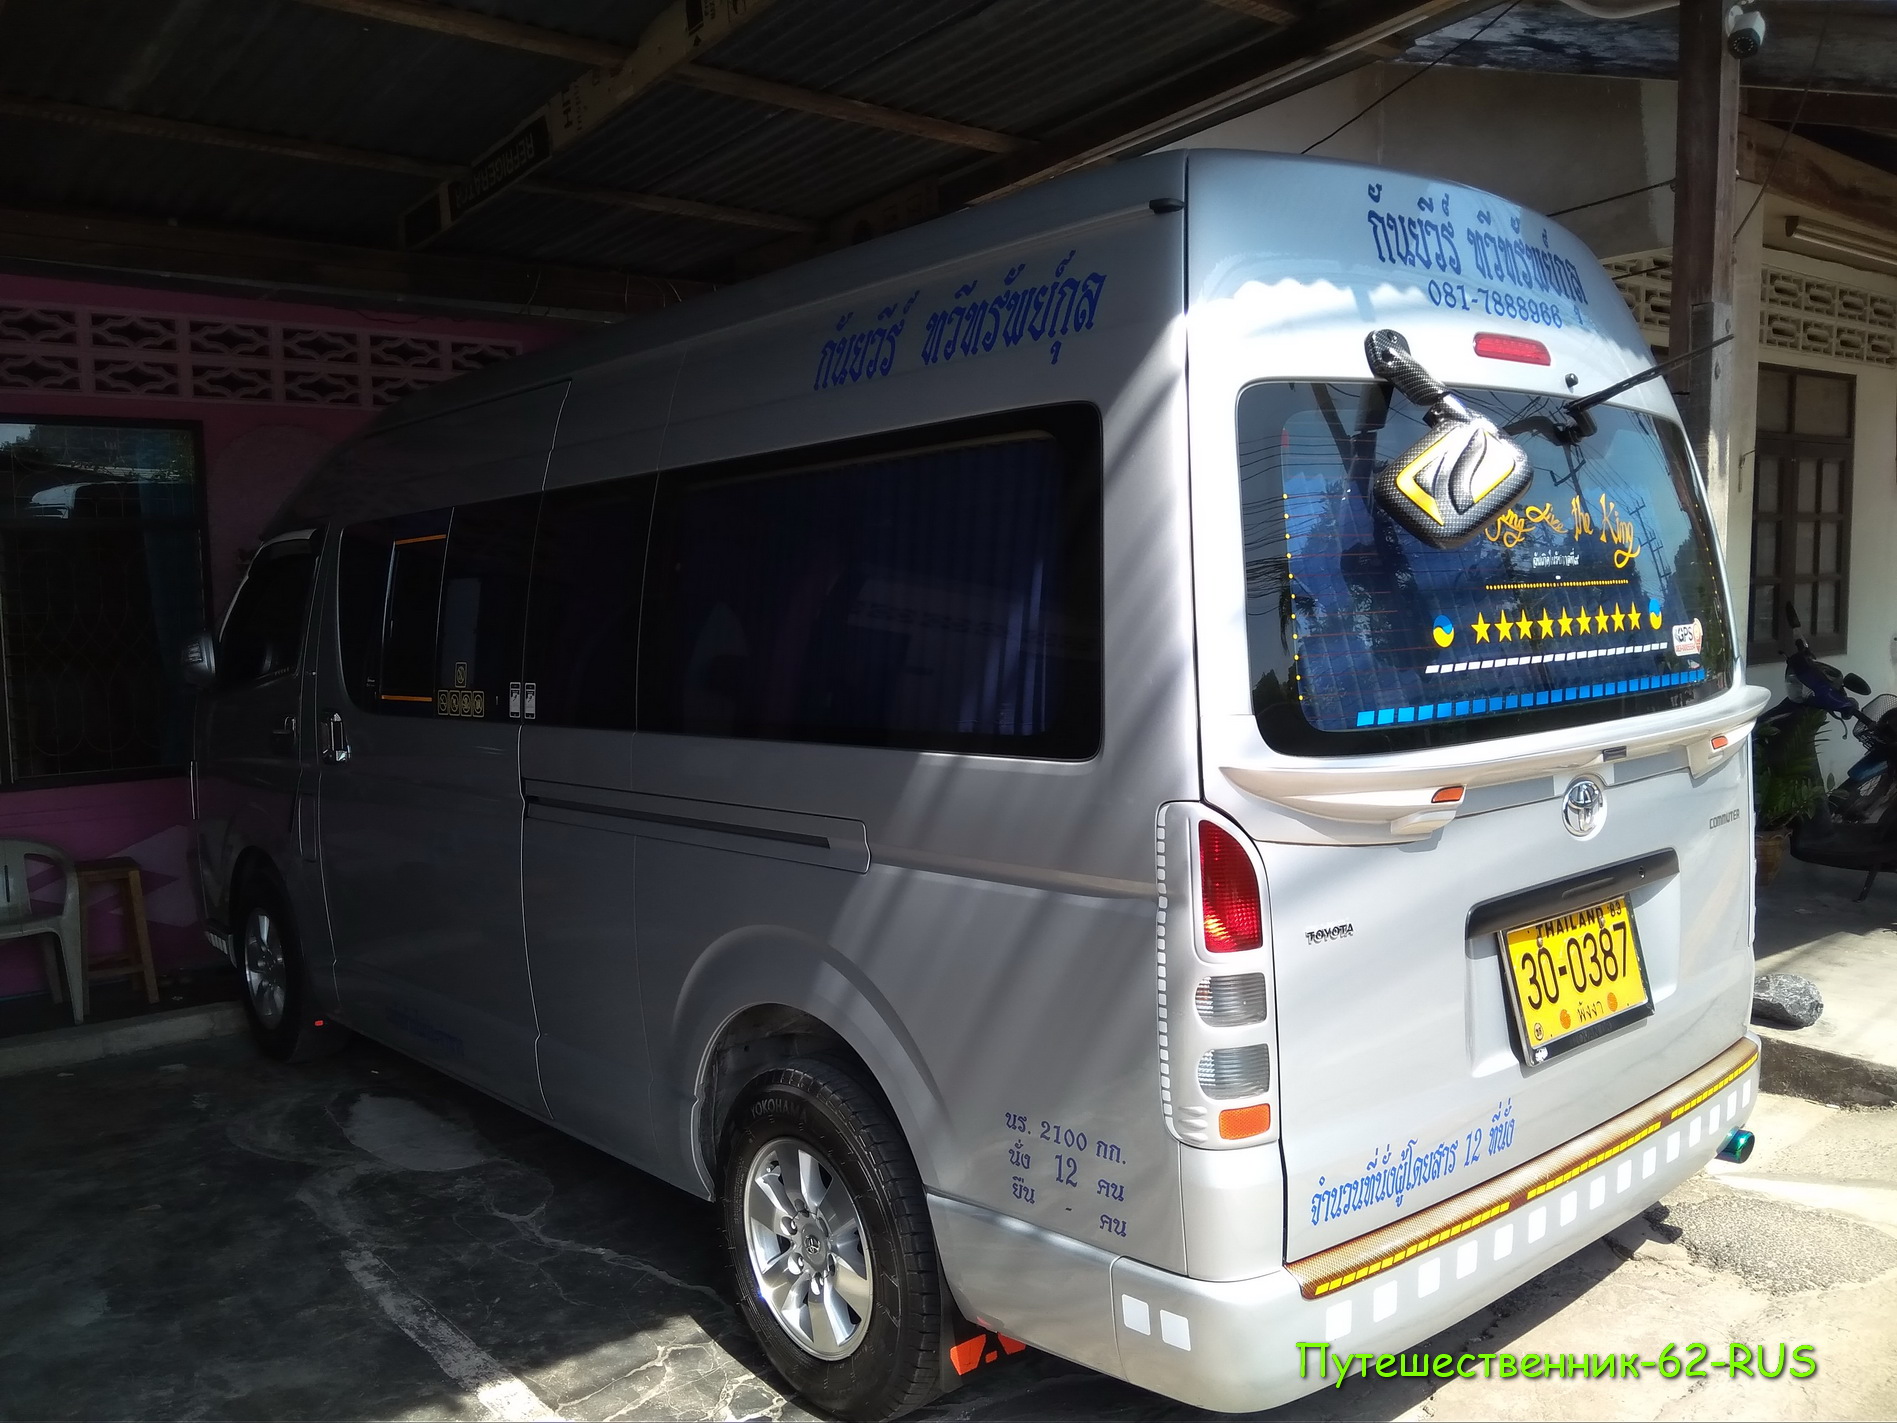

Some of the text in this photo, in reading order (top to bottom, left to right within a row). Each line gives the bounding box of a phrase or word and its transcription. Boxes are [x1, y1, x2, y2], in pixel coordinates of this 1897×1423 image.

[1428, 279, 1563, 329] 081-7888966
[1484, 508, 1536, 548] ng
[1571, 495, 1593, 542] the
[1599, 493, 1641, 569] King
[1676, 625, 1693, 642] GPS
[1709, 808, 1740, 830] COMMUTER
[1306, 923, 1354, 943] TOYOTA
[1535, 907, 1604, 939] THAILAND
[1521, 921, 1627, 1010] 30-0387
[1577, 1001, 1605, 1023] พังงา
[751, 1098, 808, 1124] YOKOHAMA
[1040, 1121, 1087, 1151] 2100
[1096, 1141, 1126, 1165] กก.
[1311, 1097, 1516, 1226] จำนวนที่นั่งผู้โดยสาร 12 ที่นั่ง
[1008, 1139, 1125, 1202] นั่ง 12 คน
[1012, 1175, 1036, 1204] ยืน
[1099, 1214, 1127, 1238] คน
